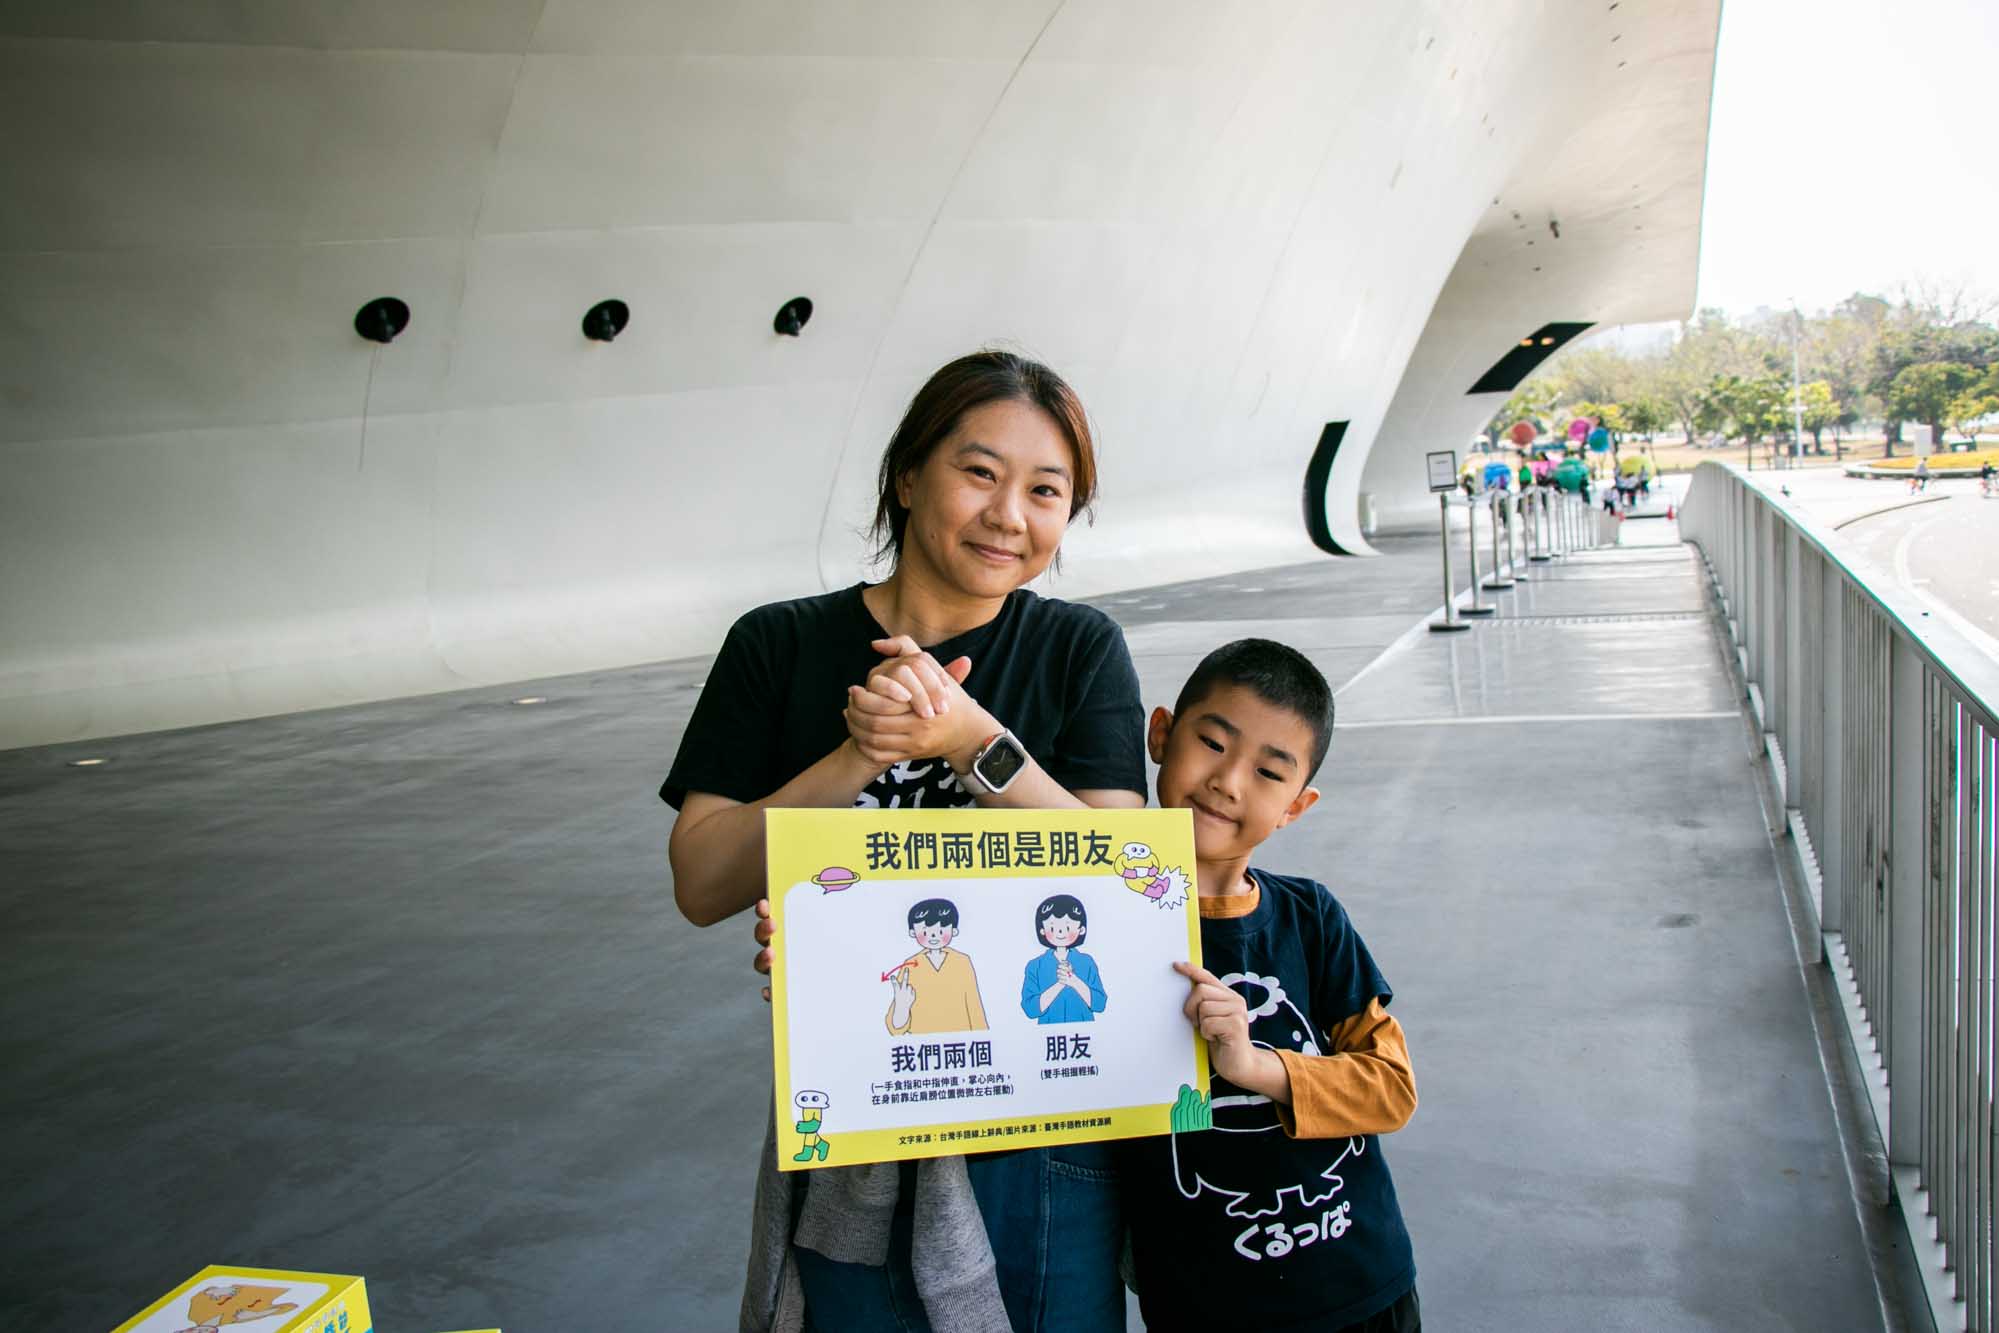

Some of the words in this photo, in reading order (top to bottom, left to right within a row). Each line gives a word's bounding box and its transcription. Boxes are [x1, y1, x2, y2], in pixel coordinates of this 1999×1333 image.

[866, 829, 1114, 870] 我們兩個是朋友
[891, 1040, 993, 1072] 我們兩個
[1046, 1033, 1091, 1061] 朋友
